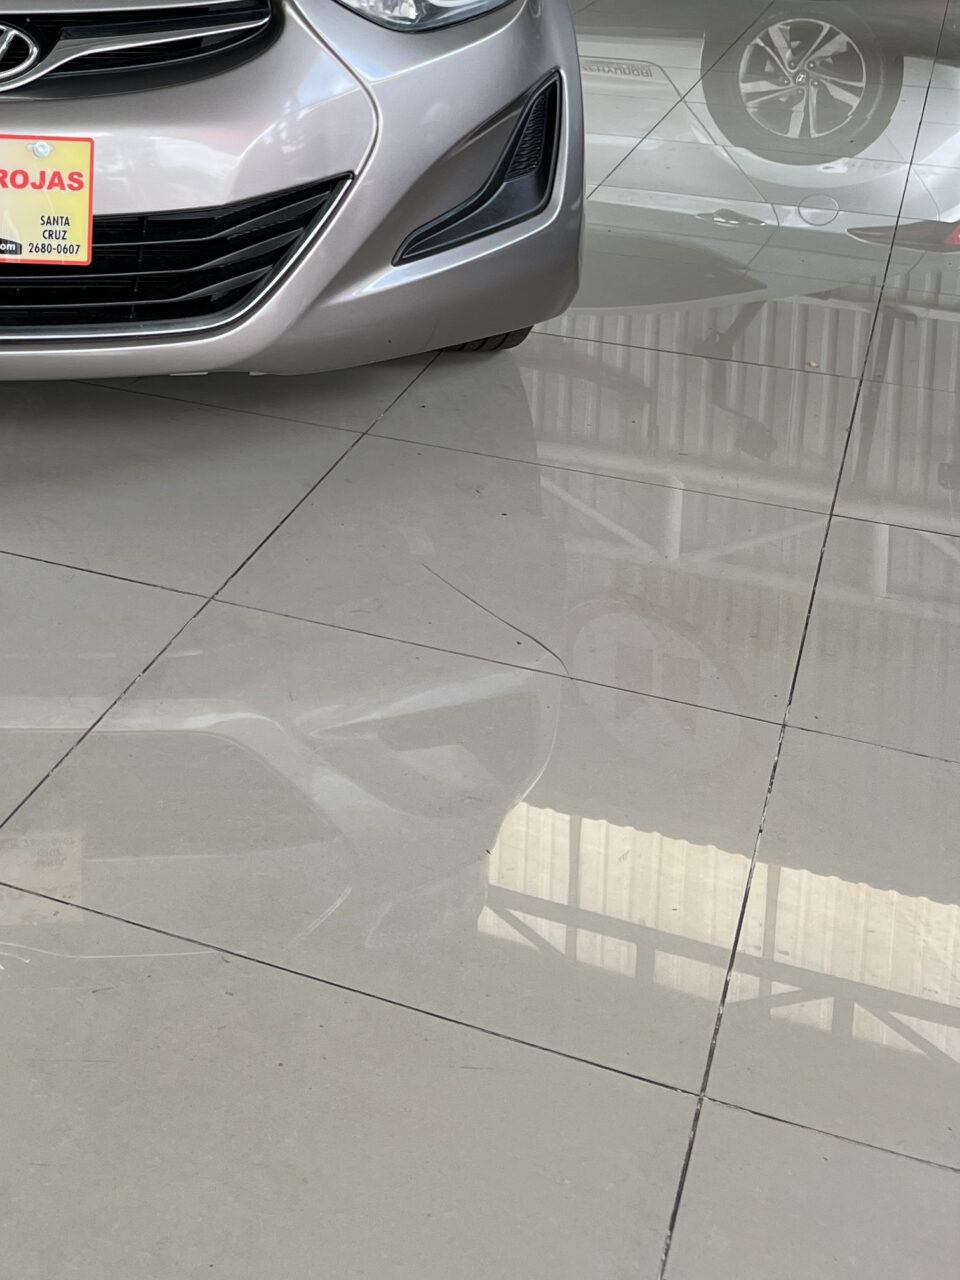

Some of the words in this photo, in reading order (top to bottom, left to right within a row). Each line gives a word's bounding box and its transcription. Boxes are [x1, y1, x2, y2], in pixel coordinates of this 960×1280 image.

[40, 215, 71, 227] SANTA
[42, 229, 68, 241] CRUZ
[28, 242, 81, 255] 2680-0607
